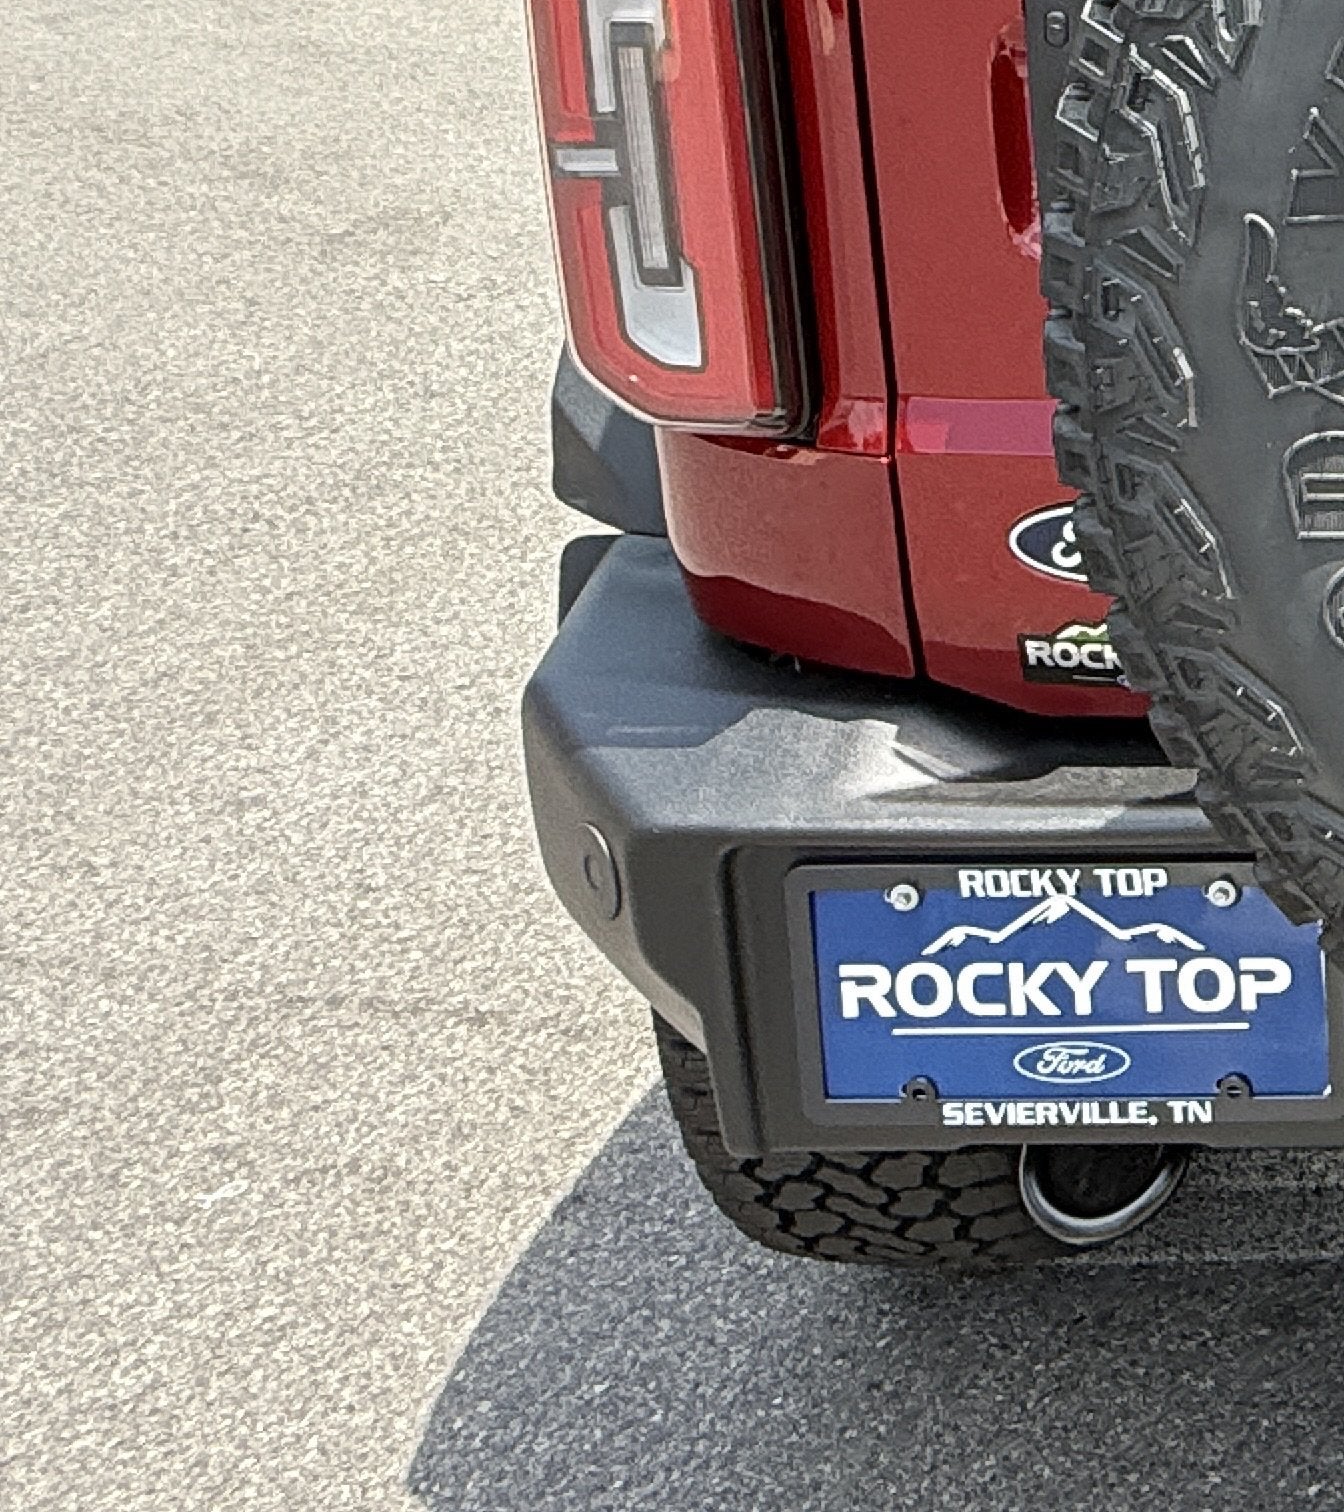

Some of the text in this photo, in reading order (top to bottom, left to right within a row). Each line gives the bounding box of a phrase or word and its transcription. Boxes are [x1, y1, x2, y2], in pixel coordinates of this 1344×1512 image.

[959, 868, 1168, 898] ROCKY TOP
[838, 956, 1292, 1019] ROCKY TOP
[1036, 1046, 1107, 1075] Ford
[942, 1100, 1212, 1126] SEVIERVILLE, TN
